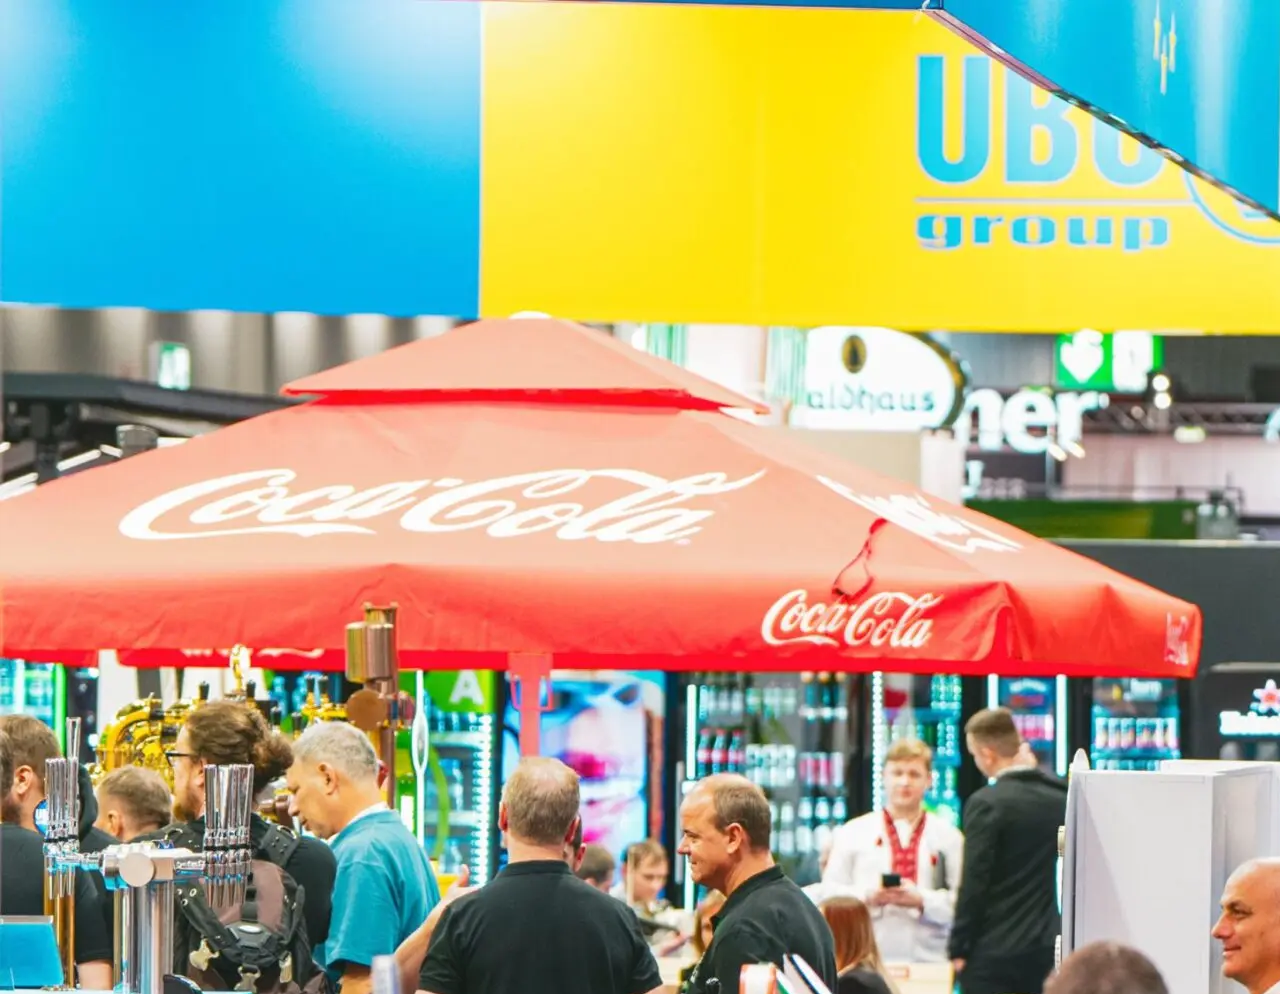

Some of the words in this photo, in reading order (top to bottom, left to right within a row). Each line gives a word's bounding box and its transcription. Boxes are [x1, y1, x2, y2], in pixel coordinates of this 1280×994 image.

[915, 213, 1170, 251] group
[118, 467, 769, 545] Coca-Cola
[760, 588, 944, 648] Coca-Cola
